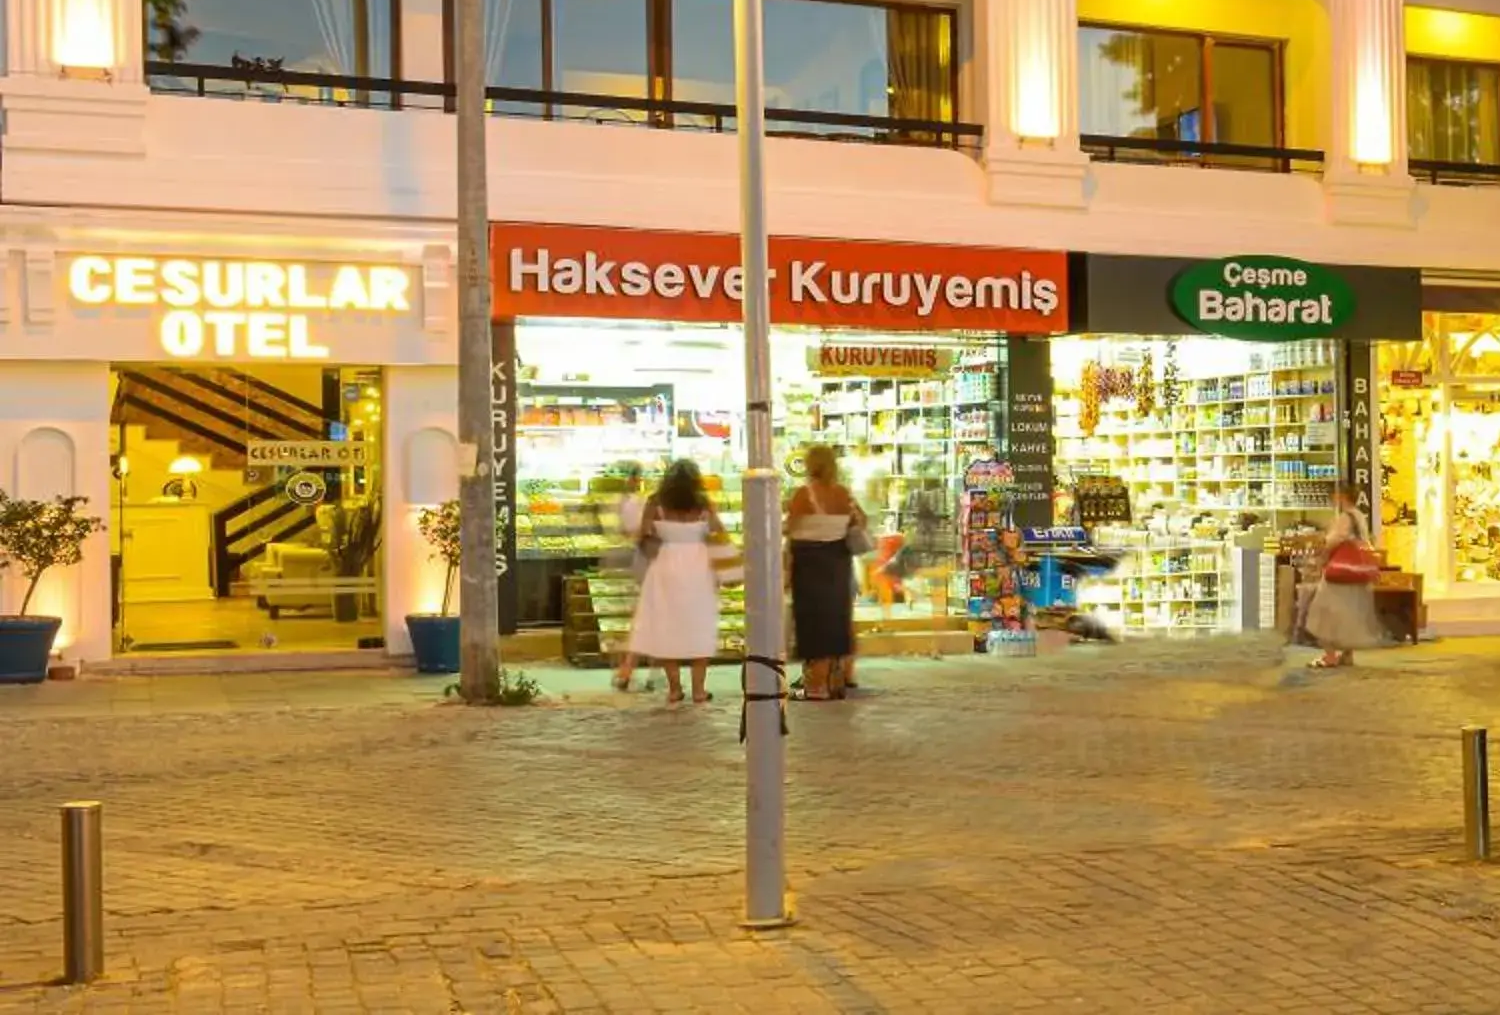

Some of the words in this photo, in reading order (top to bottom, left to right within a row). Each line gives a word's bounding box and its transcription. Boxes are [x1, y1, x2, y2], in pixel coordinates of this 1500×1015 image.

[69, 256, 410, 310] CESURLAR
[510, 247, 777, 300] Hakseve
[791, 260, 1059, 317] Kuruyemiş
[1223, 262, 1307, 288] Çeşme
[1199, 289, 1333, 325] Baharat
[160, 310, 330, 358] OTEL
